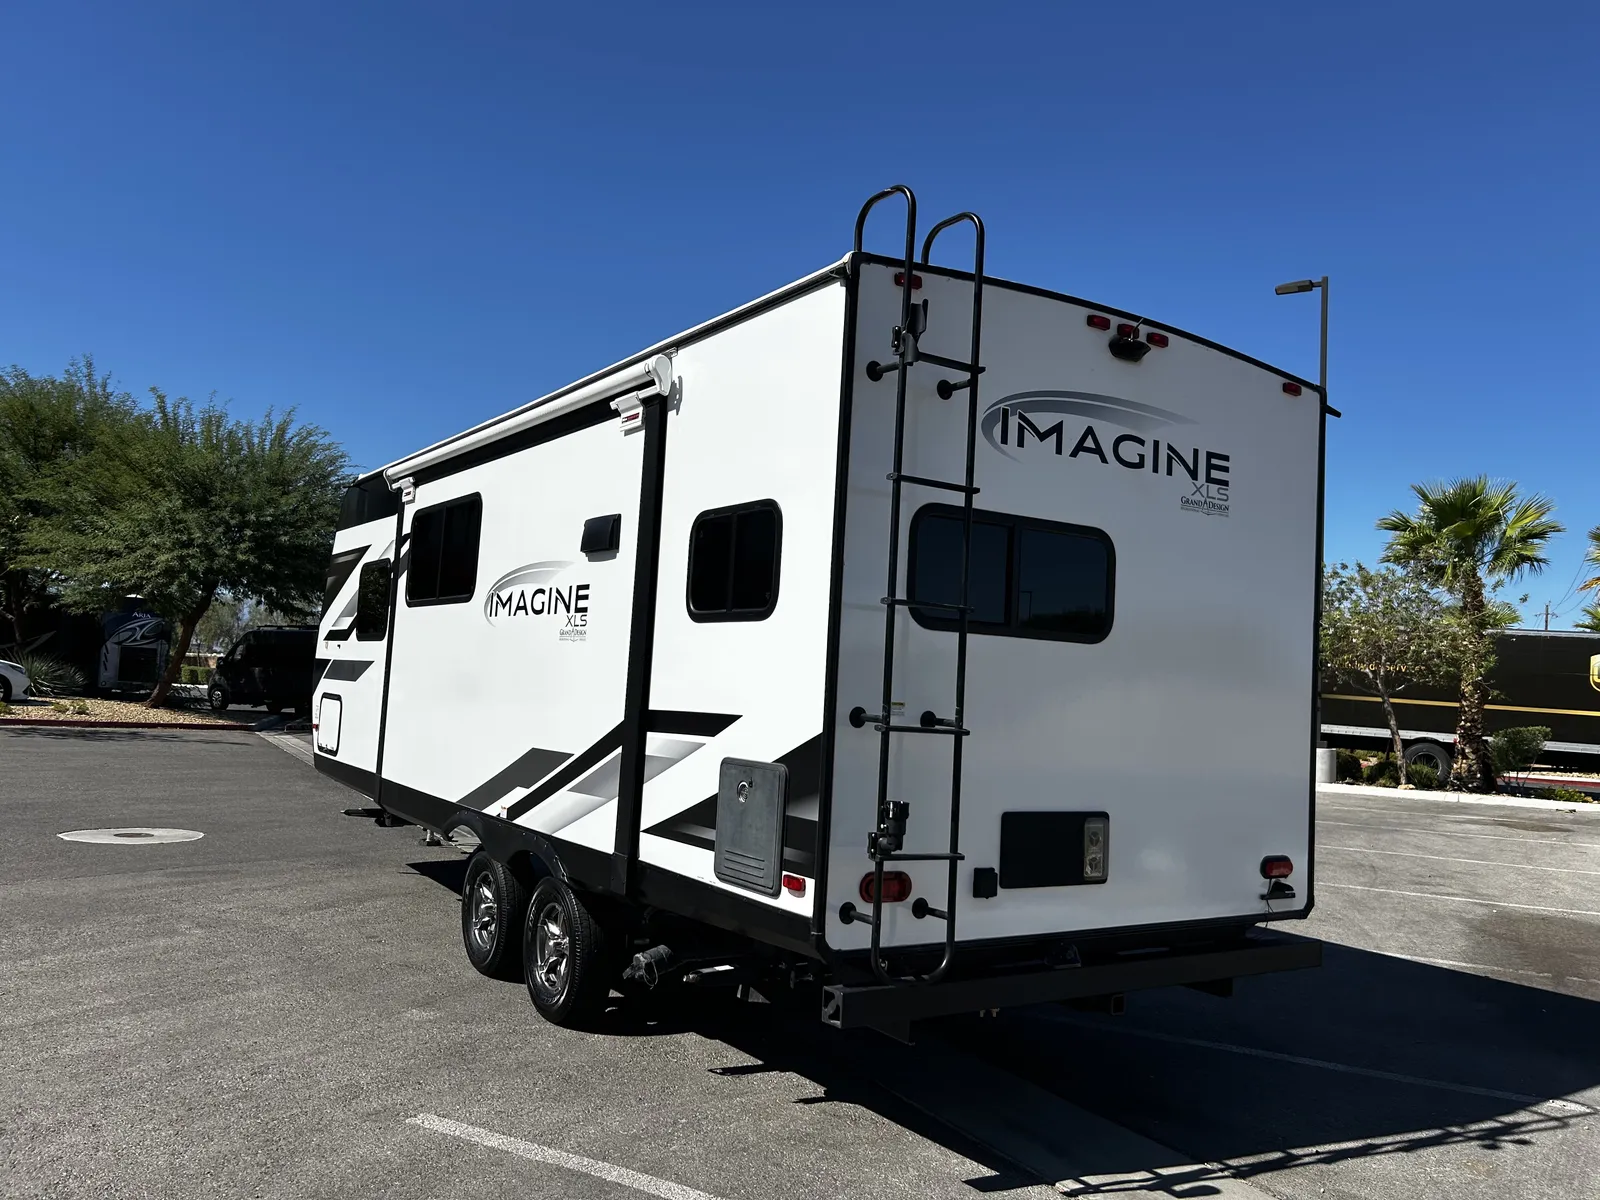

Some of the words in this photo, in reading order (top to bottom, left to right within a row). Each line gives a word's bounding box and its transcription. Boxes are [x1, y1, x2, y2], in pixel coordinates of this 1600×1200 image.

[1000, 407, 1230, 487] IMAGINE
[1191, 481, 1230, 502] XLS
[1180, 495, 1203, 507] GRAND
[1208, 501, 1230, 511] DESIGN
[488, 583, 590, 617] IMAGINE
[132, 611, 152, 619] ARIA
[565, 614, 588, 627] XLS
